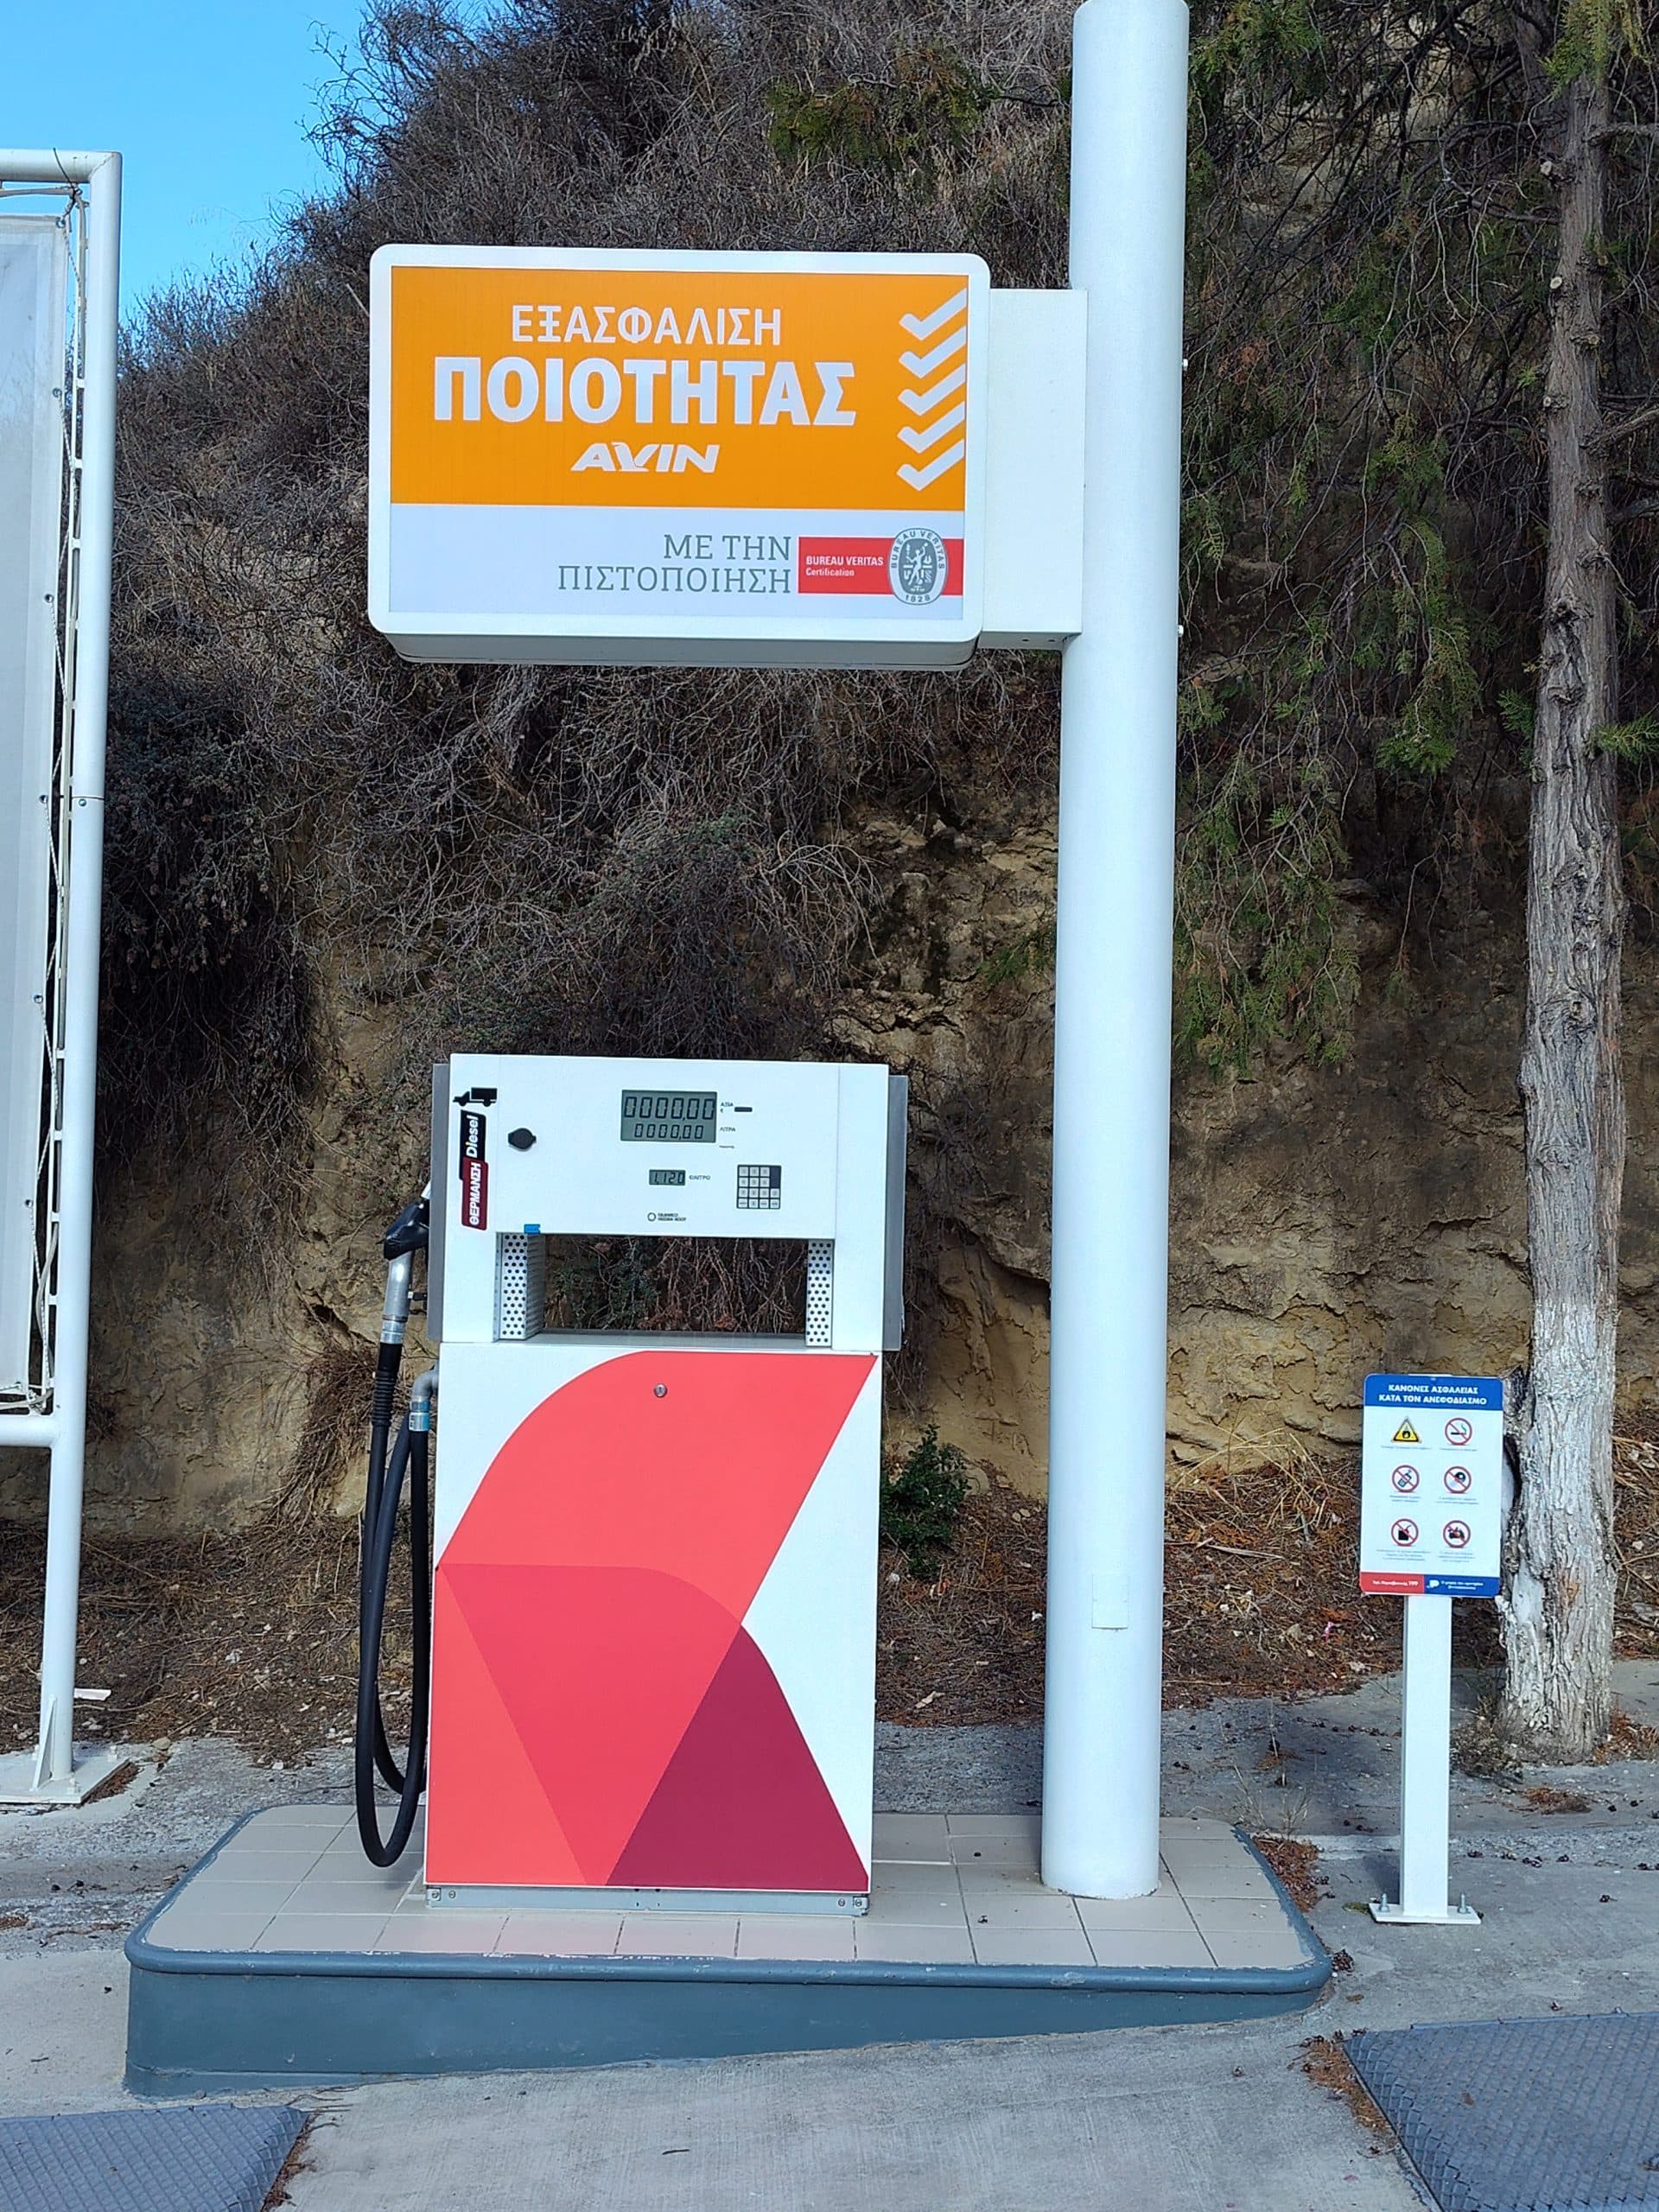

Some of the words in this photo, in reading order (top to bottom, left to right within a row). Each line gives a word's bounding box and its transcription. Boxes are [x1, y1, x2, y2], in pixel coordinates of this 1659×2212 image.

[512, 305, 782, 346] ΕΞΑΣΦΑΛΙΣΗ
[434, 355, 857, 426] ΠΟΙΟΤΗΤΑΣ
[570, 442, 720, 474] AVIN
[664, 534, 713, 560] ΜΕ
[722, 535, 791, 561] ΤΗΝ
[806, 556, 844, 566] BUREAU
[846, 556, 884, 566] VERITAS
[891, 531, 916, 569] BUREAU
[920, 530, 945, 569] VERITAS
[558, 565, 791, 594] ΠΙΣΤΟΠΟΙΗΣΗ
[806, 568, 855, 576] Certification
[466, 1115, 480, 1158] Diesel
[469, 1162, 481, 1225] ΘΕΡΜΑΝΣΗ
[1388, 1384, 1429, 1393] ΚΑΝΟΝΕΣ
[1431, 1385, 1478, 1394] ΑΣΦΑΛΕΙΑΣ
[1423, 1395, 1487, 1405] ΑΝΕΦΟΔΙΑΣΜΟ
